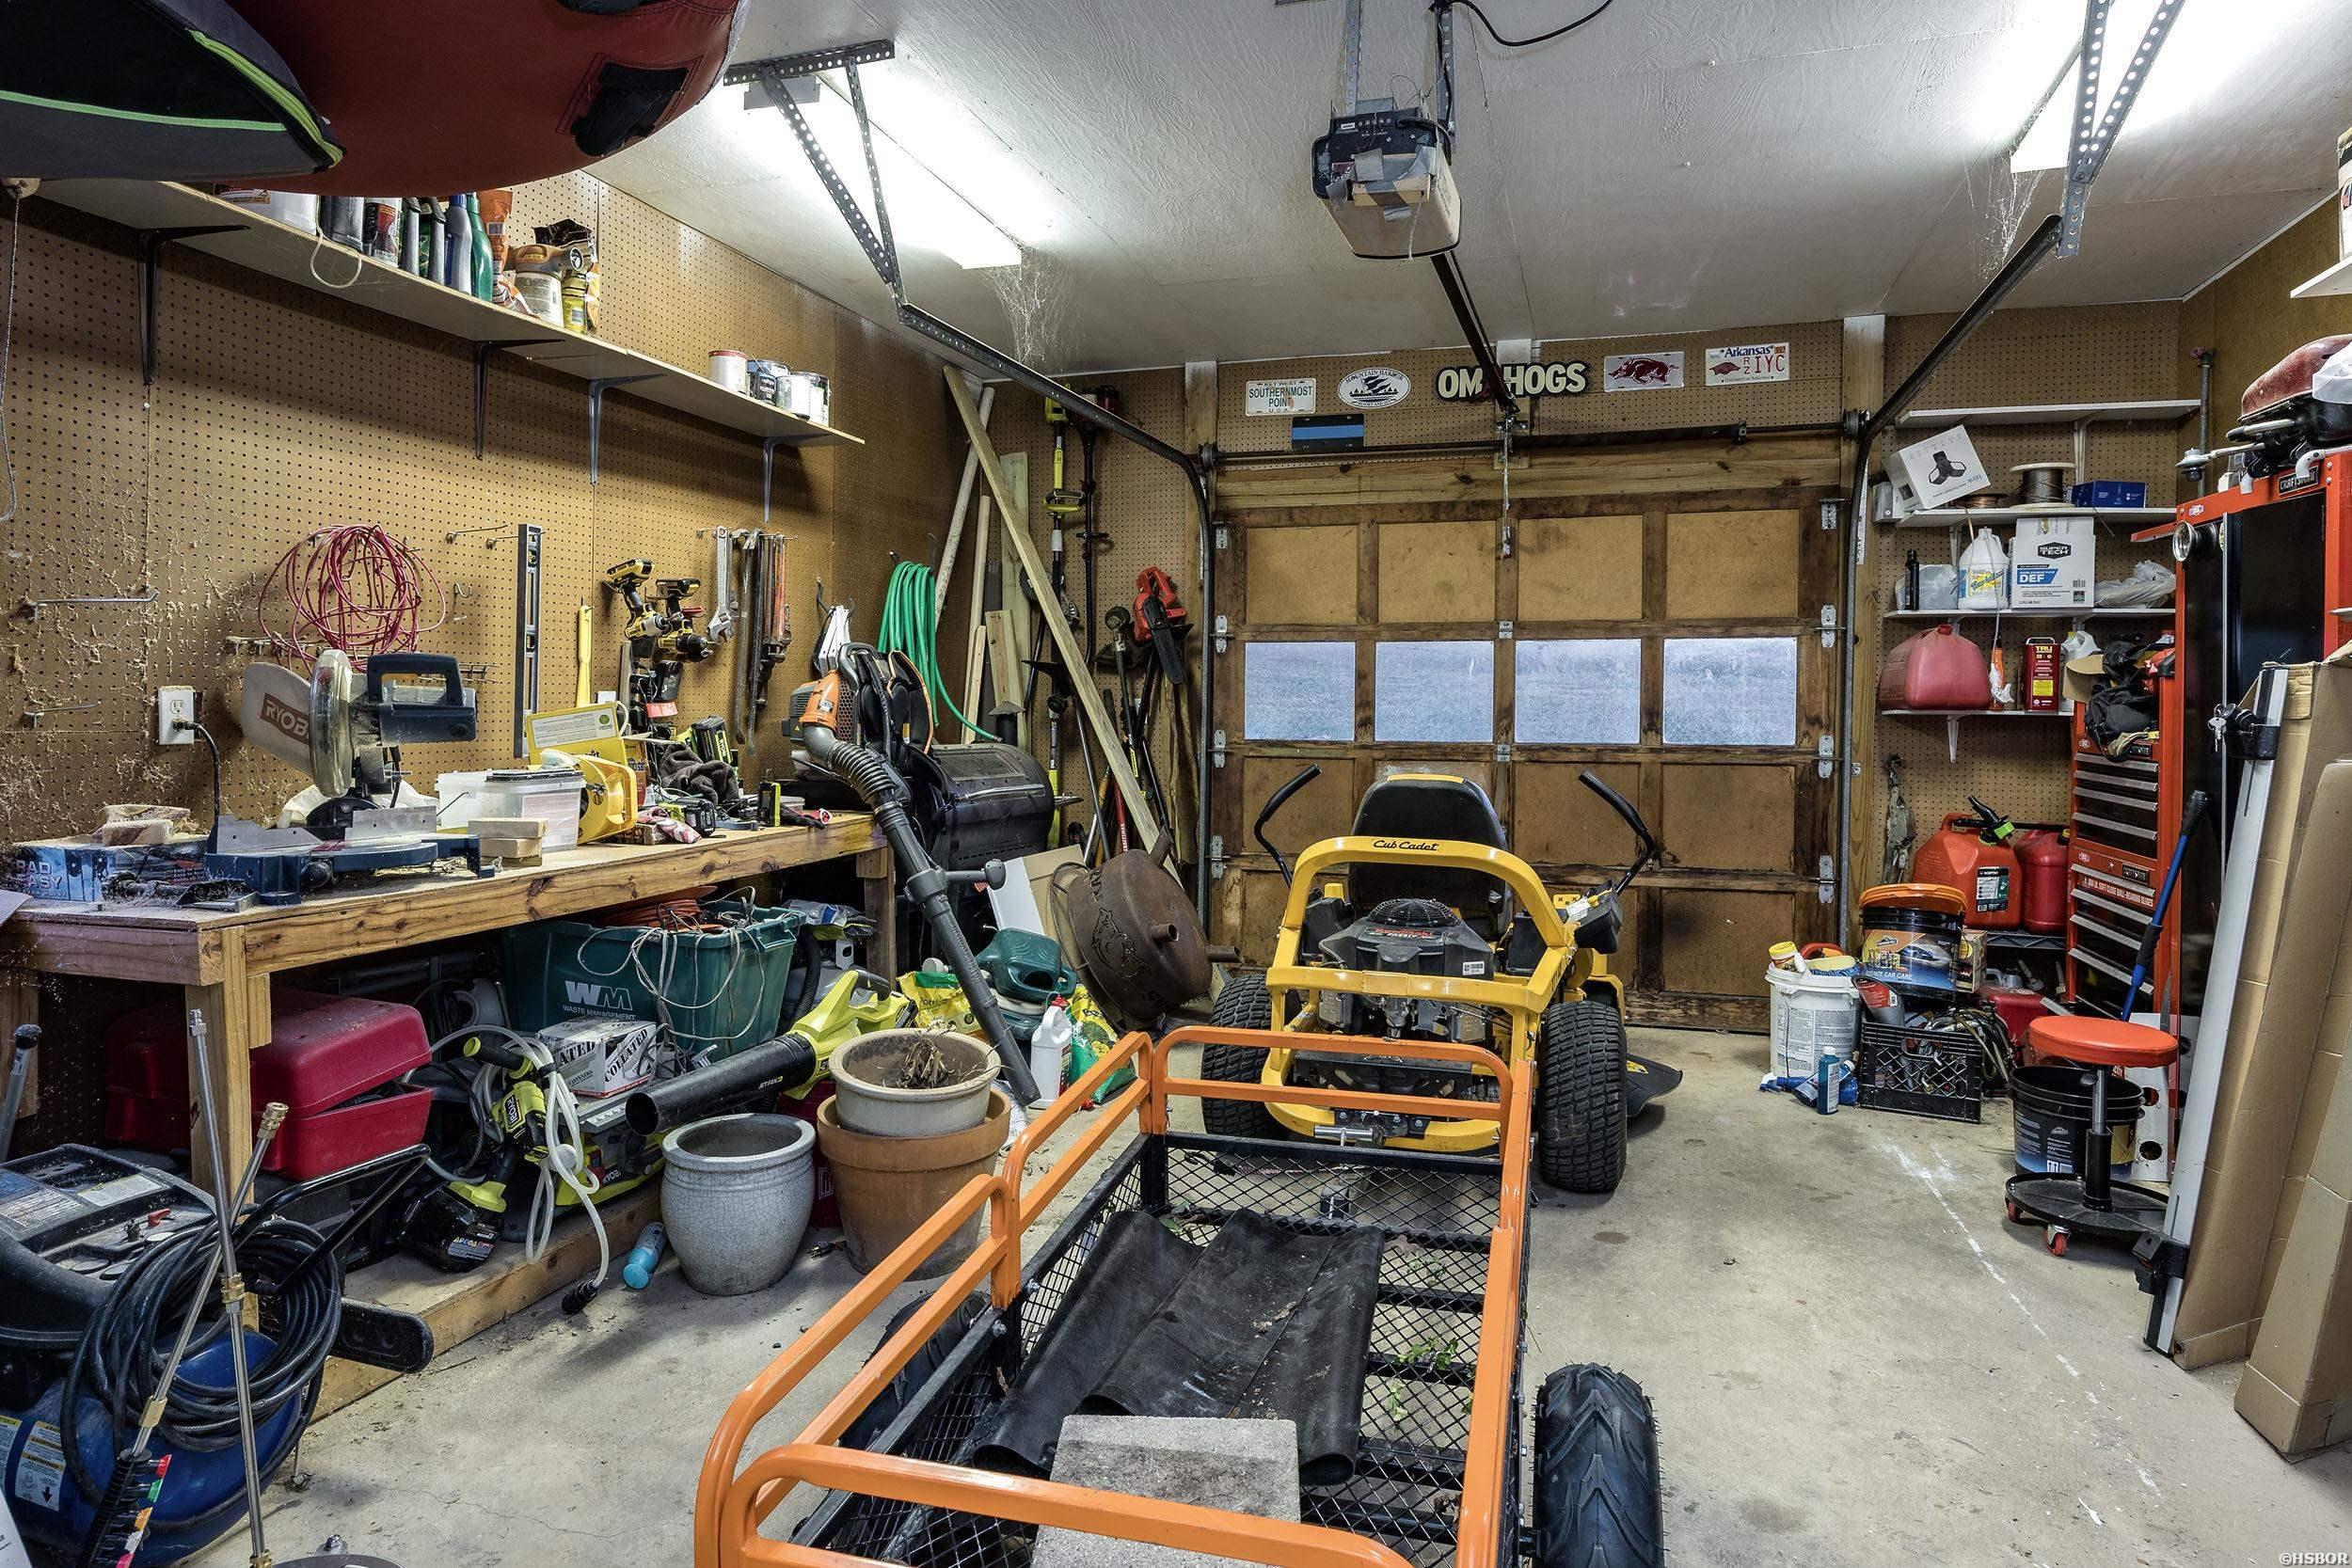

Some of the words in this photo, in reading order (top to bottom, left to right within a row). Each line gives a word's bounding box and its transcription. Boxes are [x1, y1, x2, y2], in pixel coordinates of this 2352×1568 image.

[1724, 346, 1772, 357] Arkansas
[1755, 355, 1785, 373] IYC
[1345, 370, 1378, 384] MOUNTAIN
[1379, 370, 1404, 382] HARBOR
[1248, 386, 1313, 399] SOUTHERNMOST
[1268, 397, 1293, 407] POINT
[2019, 574, 2045, 583] DEF
[266, 699, 310, 740] RYOB
[1373, 839, 1398, 848] Cub
[1399, 841, 1439, 851] Cadet
[564, 980, 633, 1010] WM
[563, 1005, 585, 1015] WASTE
[586, 1008, 637, 1021] MANAGEMENT
[604, 1028, 648, 1083] COLLATED
[568, 1069, 594, 1085] FASTENERS
[506, 1097, 518, 1124] RYOBI
